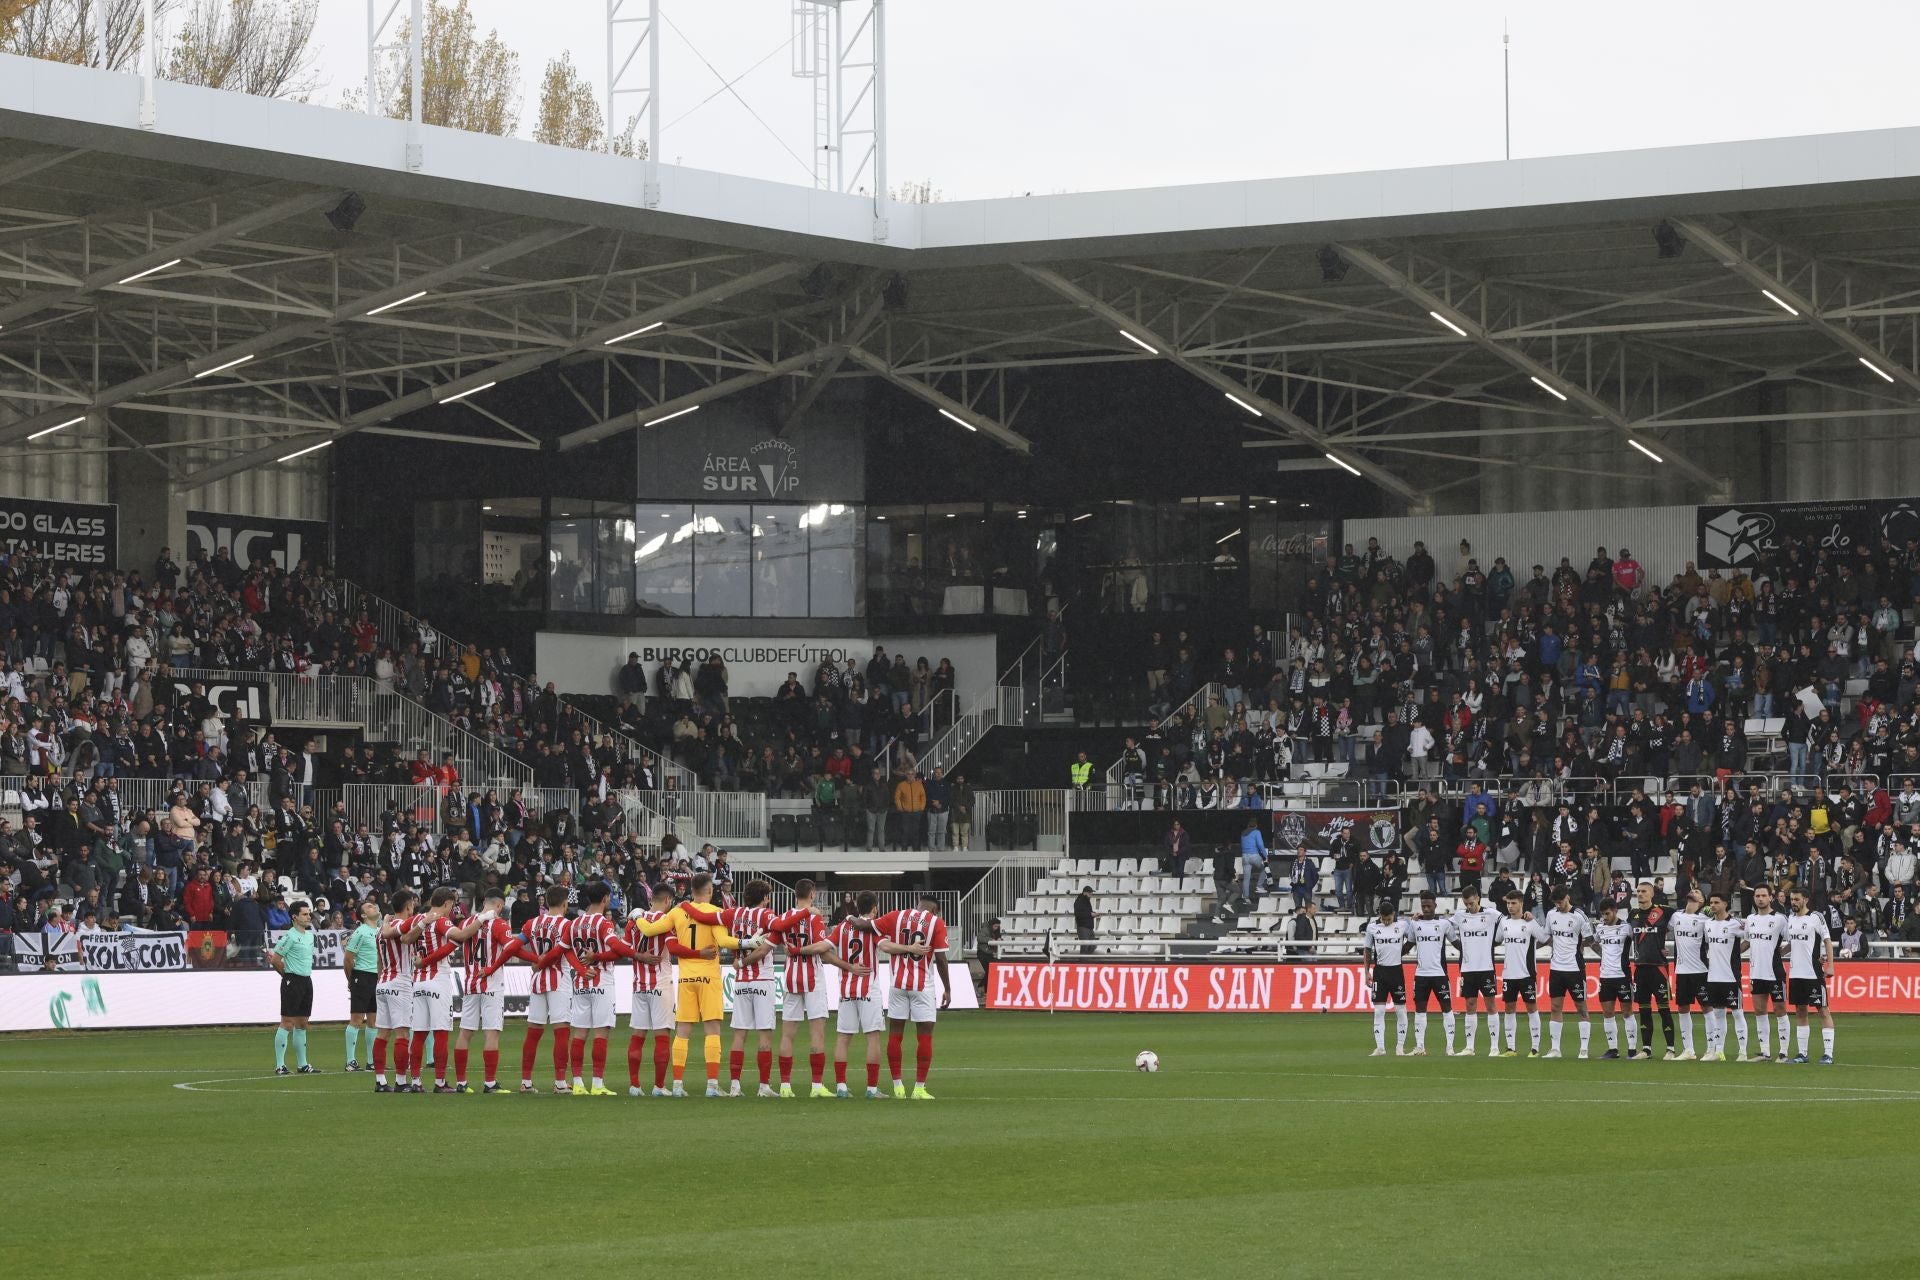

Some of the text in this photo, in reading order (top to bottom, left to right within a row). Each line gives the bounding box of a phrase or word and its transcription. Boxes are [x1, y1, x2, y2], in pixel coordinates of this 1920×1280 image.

[704, 453, 750, 472] ÁREA
[703, 476, 757, 491] SUR
[33, 514, 106, 537] GLASS
[1728, 512, 1850, 561] Redo
[174, 683, 261, 719] GI
[1328, 816, 1356, 831] Hijos
[89, 934, 118, 943] FRENTE
[688, 924, 697, 951] 1
[1552, 930, 1574, 938] DIGI
[468, 938, 487, 967] 14
[788, 933, 809, 963] 17
[849, 938, 863, 964] 2
[413, 990, 440, 999] ISSAN
[734, 988, 767, 997] NISSAN
[994, 965, 1380, 1010] EXCLUSIVAS SAN PEDR
